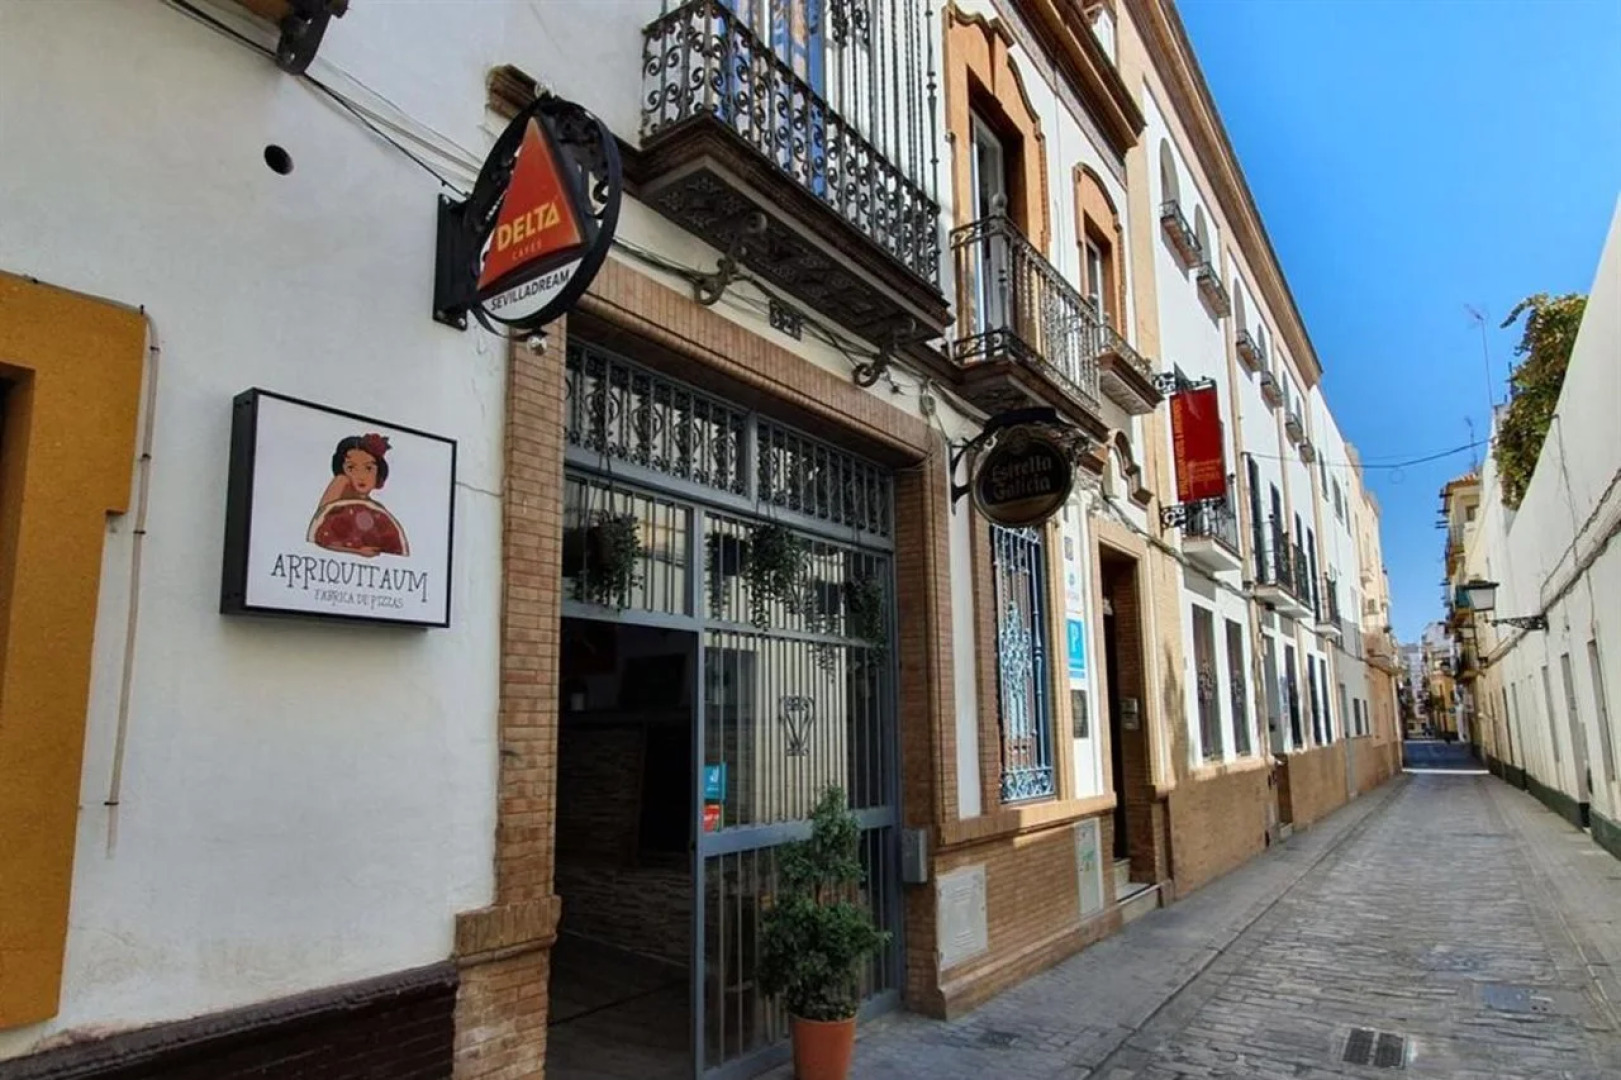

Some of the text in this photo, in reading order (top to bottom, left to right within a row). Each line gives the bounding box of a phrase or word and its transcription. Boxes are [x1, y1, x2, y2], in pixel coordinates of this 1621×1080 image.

[497, 202, 560, 252] DELTA
[490, 268, 570, 311] SEVILLADREAM
[992, 455, 1052, 482] Estrella
[993, 473, 1051, 500] Galicia
